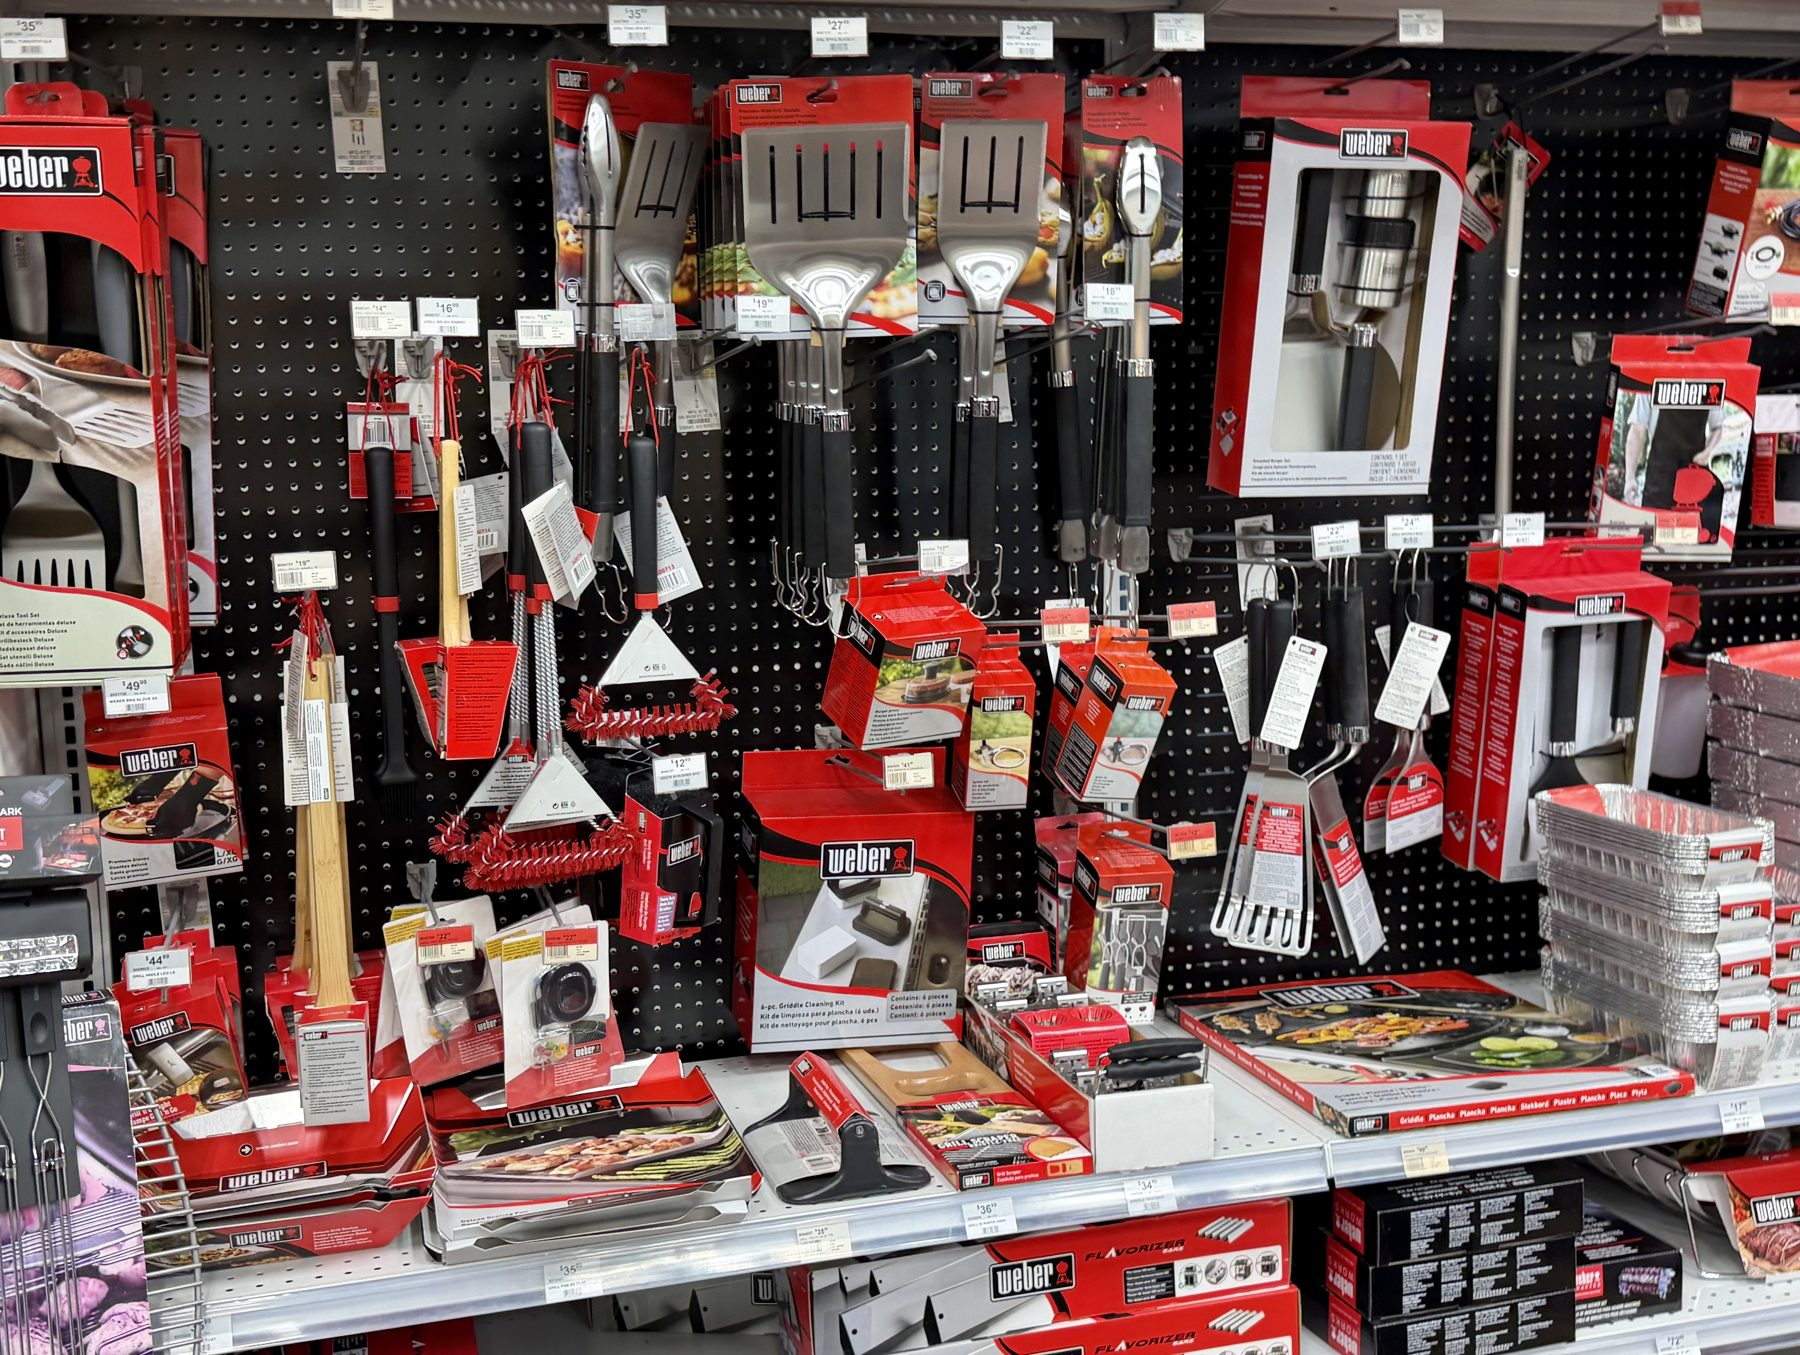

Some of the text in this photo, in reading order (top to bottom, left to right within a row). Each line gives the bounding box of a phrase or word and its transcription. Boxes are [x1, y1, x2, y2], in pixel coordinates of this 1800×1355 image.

[739, 85, 771, 102] weber
[932, 79, 962, 96] weber
[1345, 130, 1391, 157] weber
[1658, 379, 1707, 406] weber
[1579, 595, 1613, 616] weber
[915, 640, 949, 660] weber
[984, 696, 1016, 712] weber
[1127, 695, 1156, 710] weber
[126, 748, 178, 773] weber
[216, 856, 238, 865] G/XG
[671, 839, 694, 862] weber
[828, 842, 891, 874] weber
[1115, 885, 1150, 903] weber
[985, 942, 1015, 961] weber
[1274, 981, 1374, 1006] weber
[760, 1012, 770, 1020] Kit
[781, 1010, 810, 1020] limpieza
[811, 1010, 826, 1018] para
[827, 1008, 854, 1018] plancha
[778, 1002, 804, 1010] Griddle
[805, 1000, 834, 1009] Cleaning
[136, 1017, 175, 1043] weber
[477, 1019, 498, 1032] weber
[760, 1022, 769, 1030] Kit
[780, 1020, 814, 1031] nettoyage
[814, 1019, 830, 1028] pour
[575, 1045, 596, 1058] weber
[516, 1100, 593, 1124] weber
[1400, 1114, 1424, 1125] Griddle
[1428, 1111, 1455, 1122] Plancha
[1460, 1108, 1486, 1118] Plancha
[1490, 1104, 1516, 1115] Plancha
[1520, 1100, 1549, 1111] Stekbord
[1554, 1096, 1576, 1106] Piastra
[1580, 1093, 1606, 1104] Plancha
[1356, 1118, 1376, 1131] weber
[228, 1166, 300, 1189] weber
[964, 1174, 984, 1187] weber
[1755, 1195, 1795, 1223] weber
[236, 1228, 284, 1246] weber
[1340, 1217, 1362, 1245] weber
[1085, 1238, 1186, 1261] FLAVORIZER
[997, 1260, 1053, 1296] weber
[1333, 1271, 1354, 1299] weber
[1095, 1331, 1196, 1354] FLAVORIZER
[1337, 1328, 1359, 1355] weber
